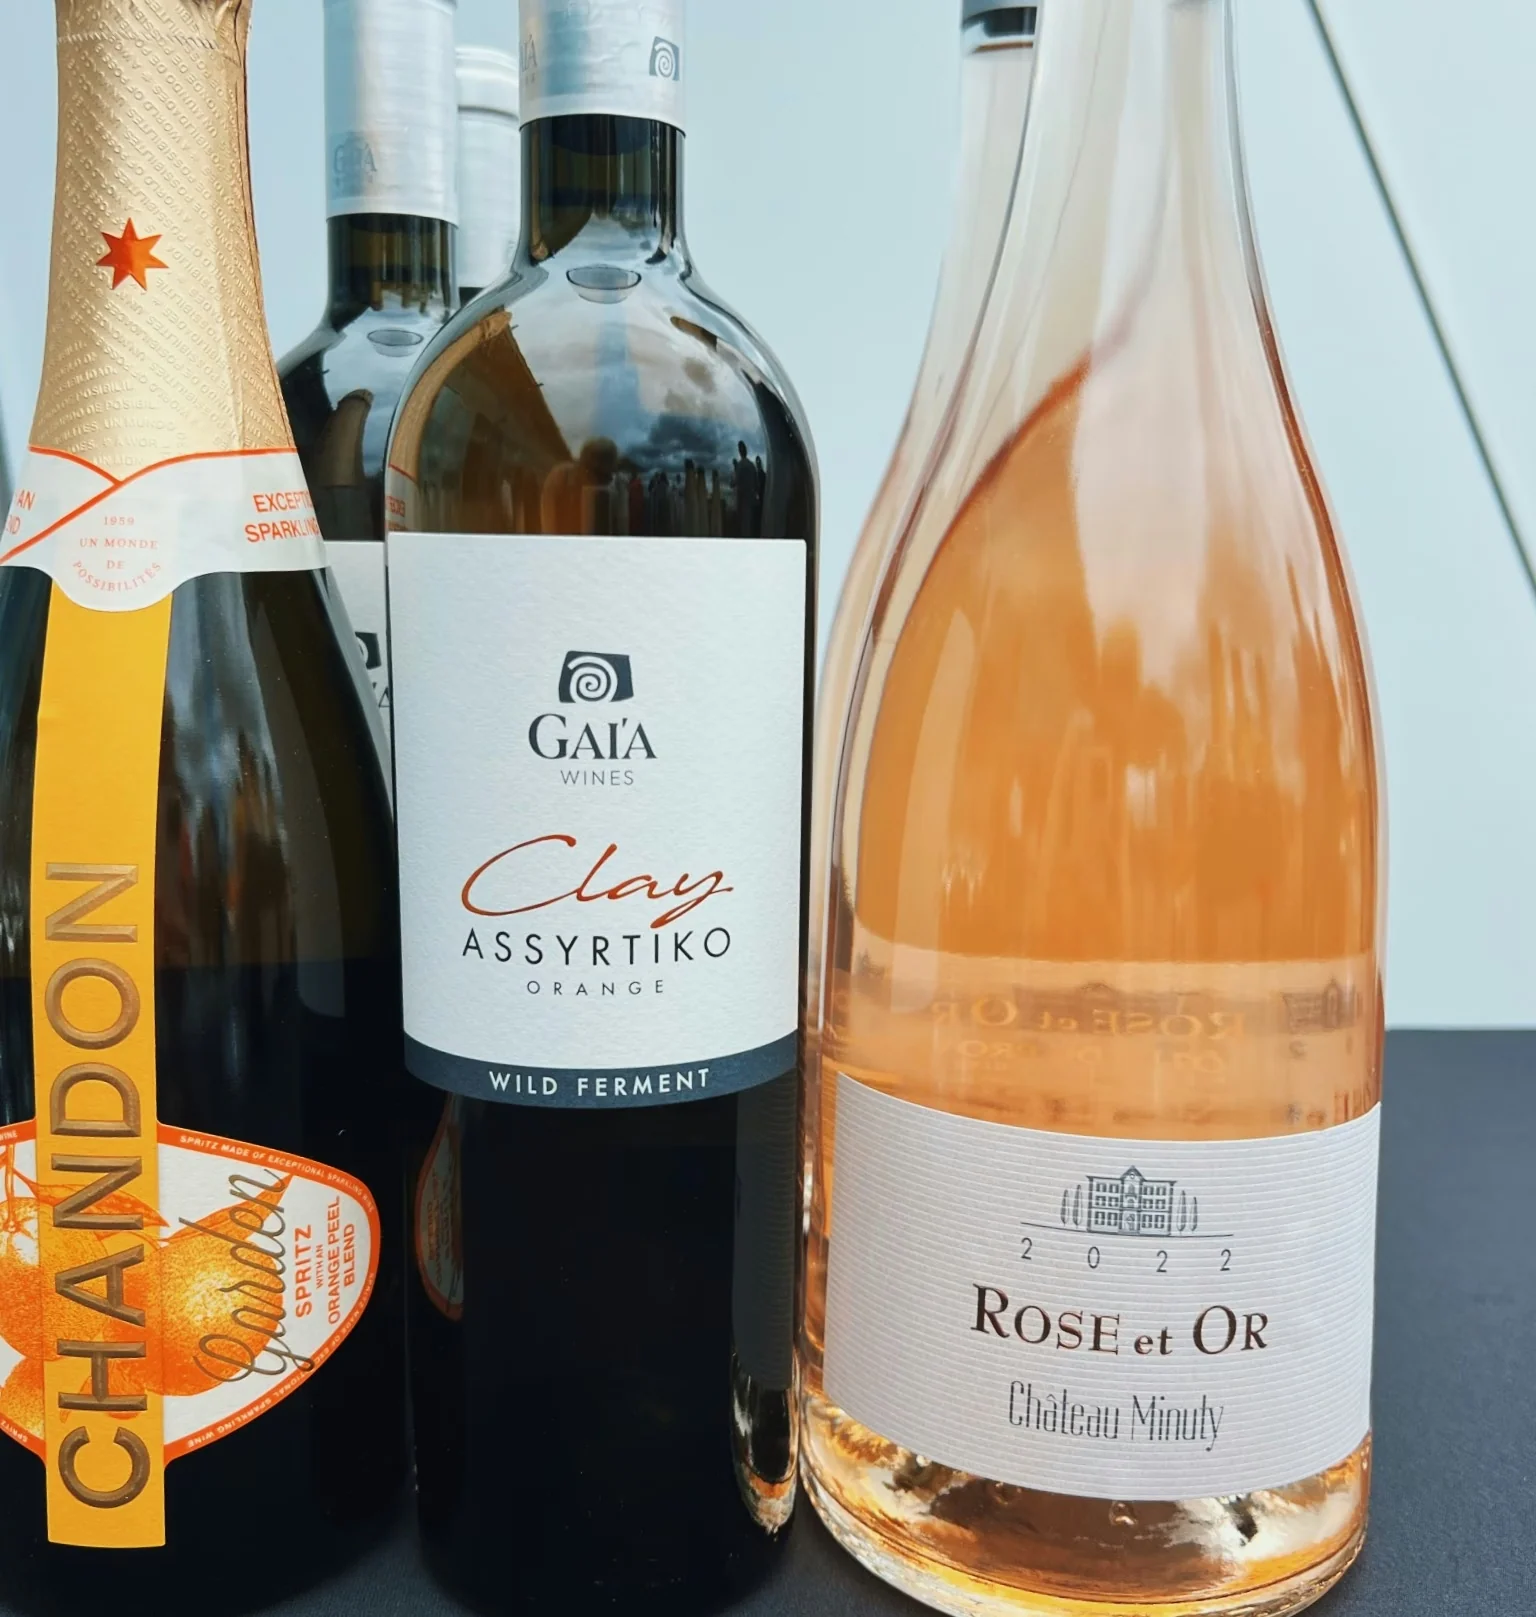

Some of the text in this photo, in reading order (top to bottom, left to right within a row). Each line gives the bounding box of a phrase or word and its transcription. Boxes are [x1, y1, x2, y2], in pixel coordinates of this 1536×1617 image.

[79, 538, 158, 549] UN MONDE
[104, 516, 135, 526] 1959
[106, 560, 125, 570] DE
[560, 770, 634, 786] WINES
[461, 834, 735, 929] Clay
[462, 927, 731, 966] ASSYRTIKO
[526, 979, 664, 996] ORANGE
[488, 1068, 711, 1097] WILD FERMENT
[179, 1134, 218, 1150] SPRITZ
[221, 1143, 250, 1157] MADE
[252, 1151, 266, 1160] OF
[268, 1155, 326, 1179] EXCEPTIONAL
[44, 861, 151, 1509] CHANDON
[178, 1168, 316, 1383] Garden
[294, 1224, 313, 1318] SPRITZ
[315, 1244, 325, 1290] WITH AN
[327, 1195, 341, 1325] ORANGE PEEL
[343, 1223, 356, 1288] BLEND
[970, 1283, 1269, 1356] ROSE et OR
[271, 1347, 331, 1398] EXCTIONAL
[1008, 1380, 1225, 1452] Château Minuty
[187, 1431, 215, 1449] WINE
